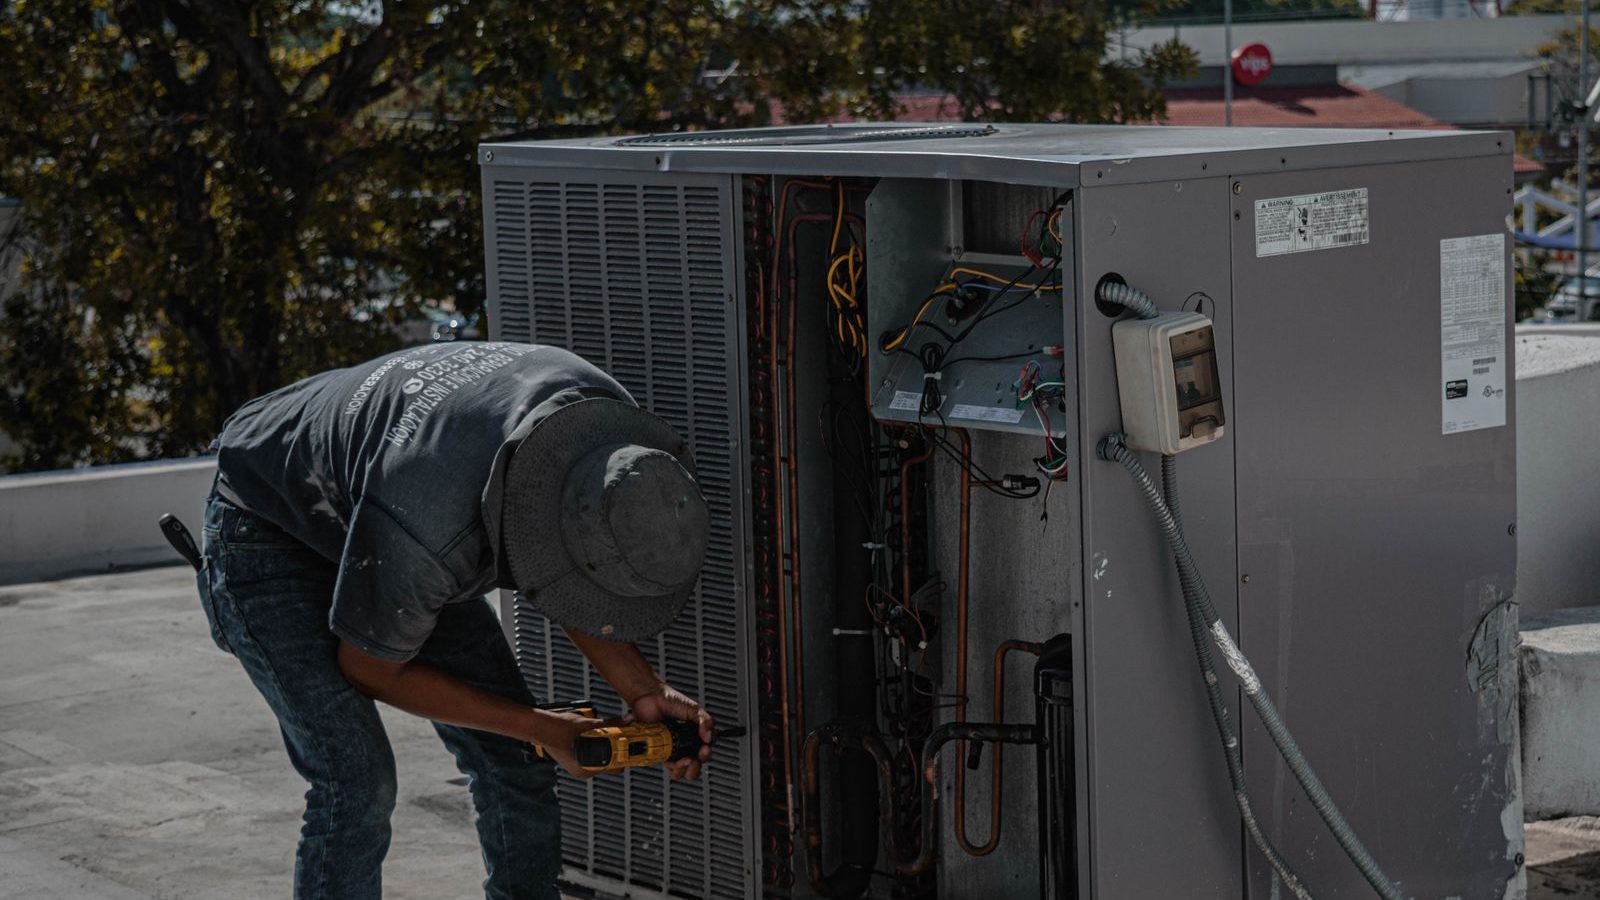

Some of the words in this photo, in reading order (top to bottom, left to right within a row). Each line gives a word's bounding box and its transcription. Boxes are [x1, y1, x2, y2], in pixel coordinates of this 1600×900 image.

[1239, 54, 1268, 76] vips
[1267, 199, 1293, 208] WARNING
[416, 360, 459, 380] 3230
[385, 382, 452, 447] INSTALACIÓN
